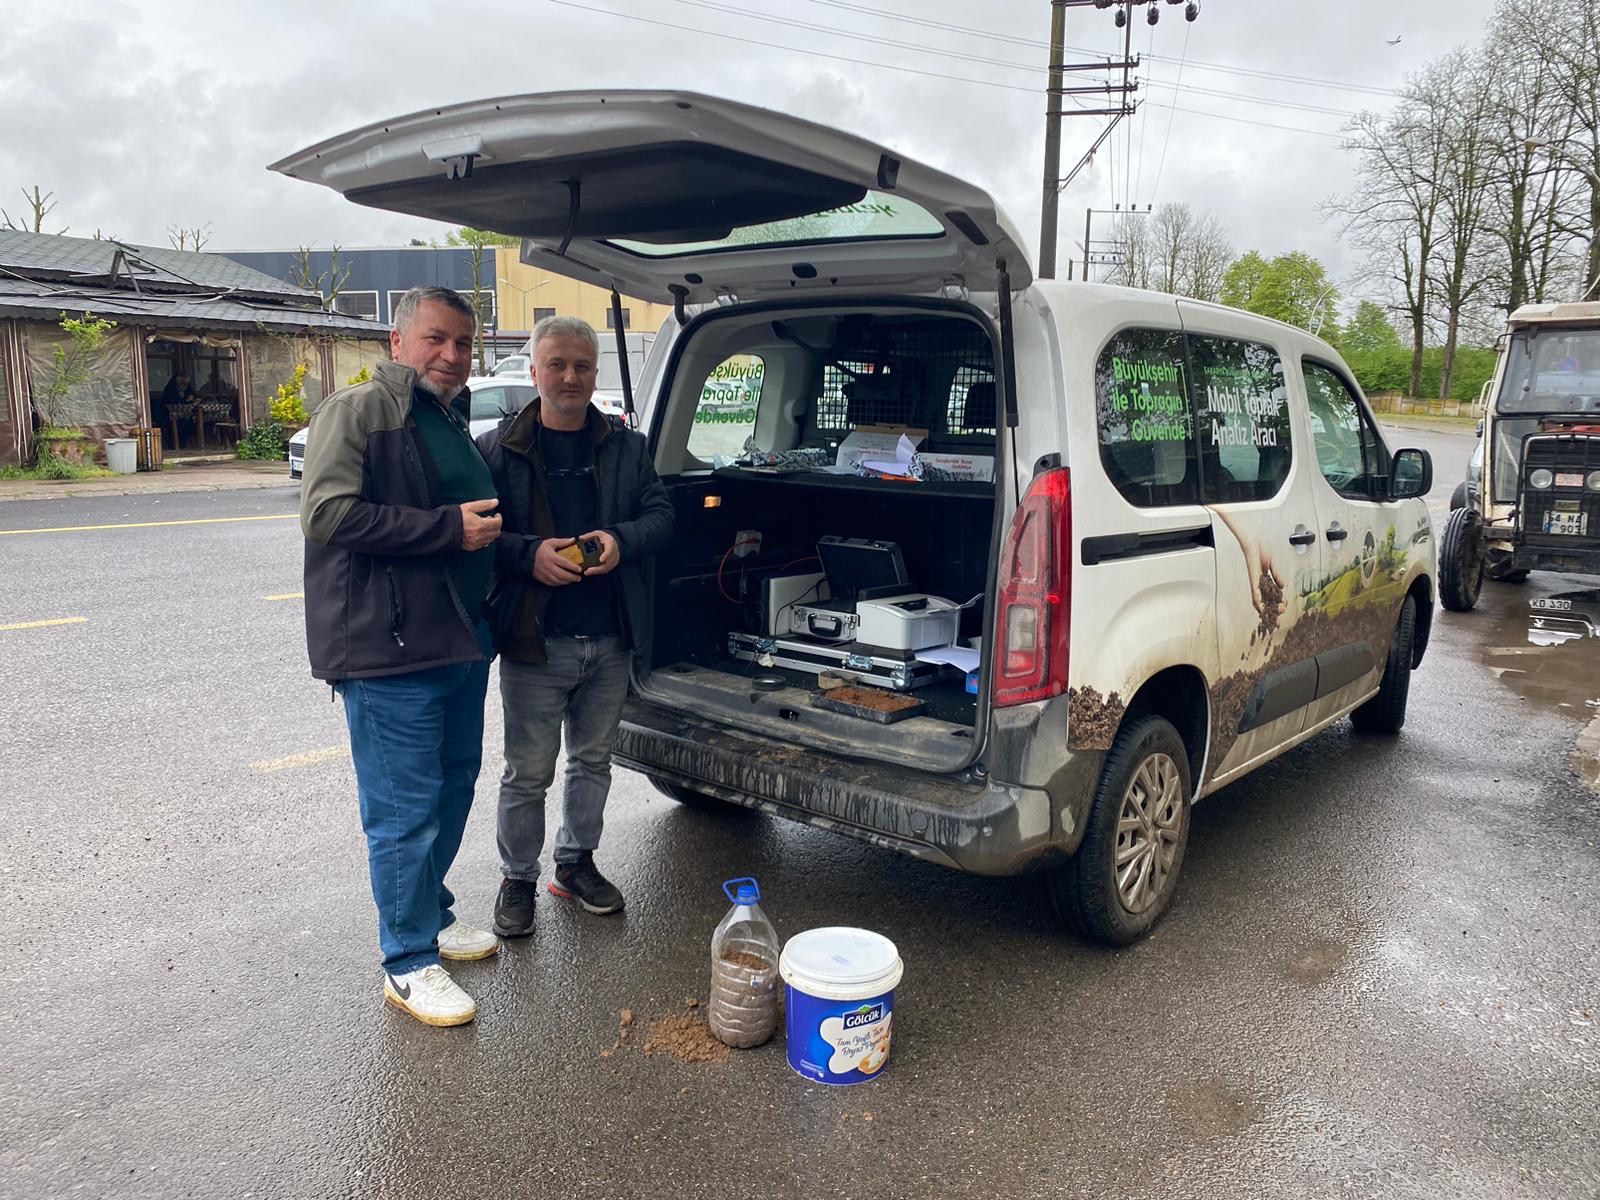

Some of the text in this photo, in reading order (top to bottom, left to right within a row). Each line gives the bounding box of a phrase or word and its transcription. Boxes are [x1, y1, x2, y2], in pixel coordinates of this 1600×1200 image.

[1112, 357, 1178, 386] Büyükşehir
[1111, 385, 1184, 416] ile Toprağın
[1206, 384, 1282, 422] Mobil Toprak
[1132, 418, 1186, 442] Güvende
[1211, 418, 1277, 447] Analiz Aracı
[846, 1009, 880, 1027] Gölcük
